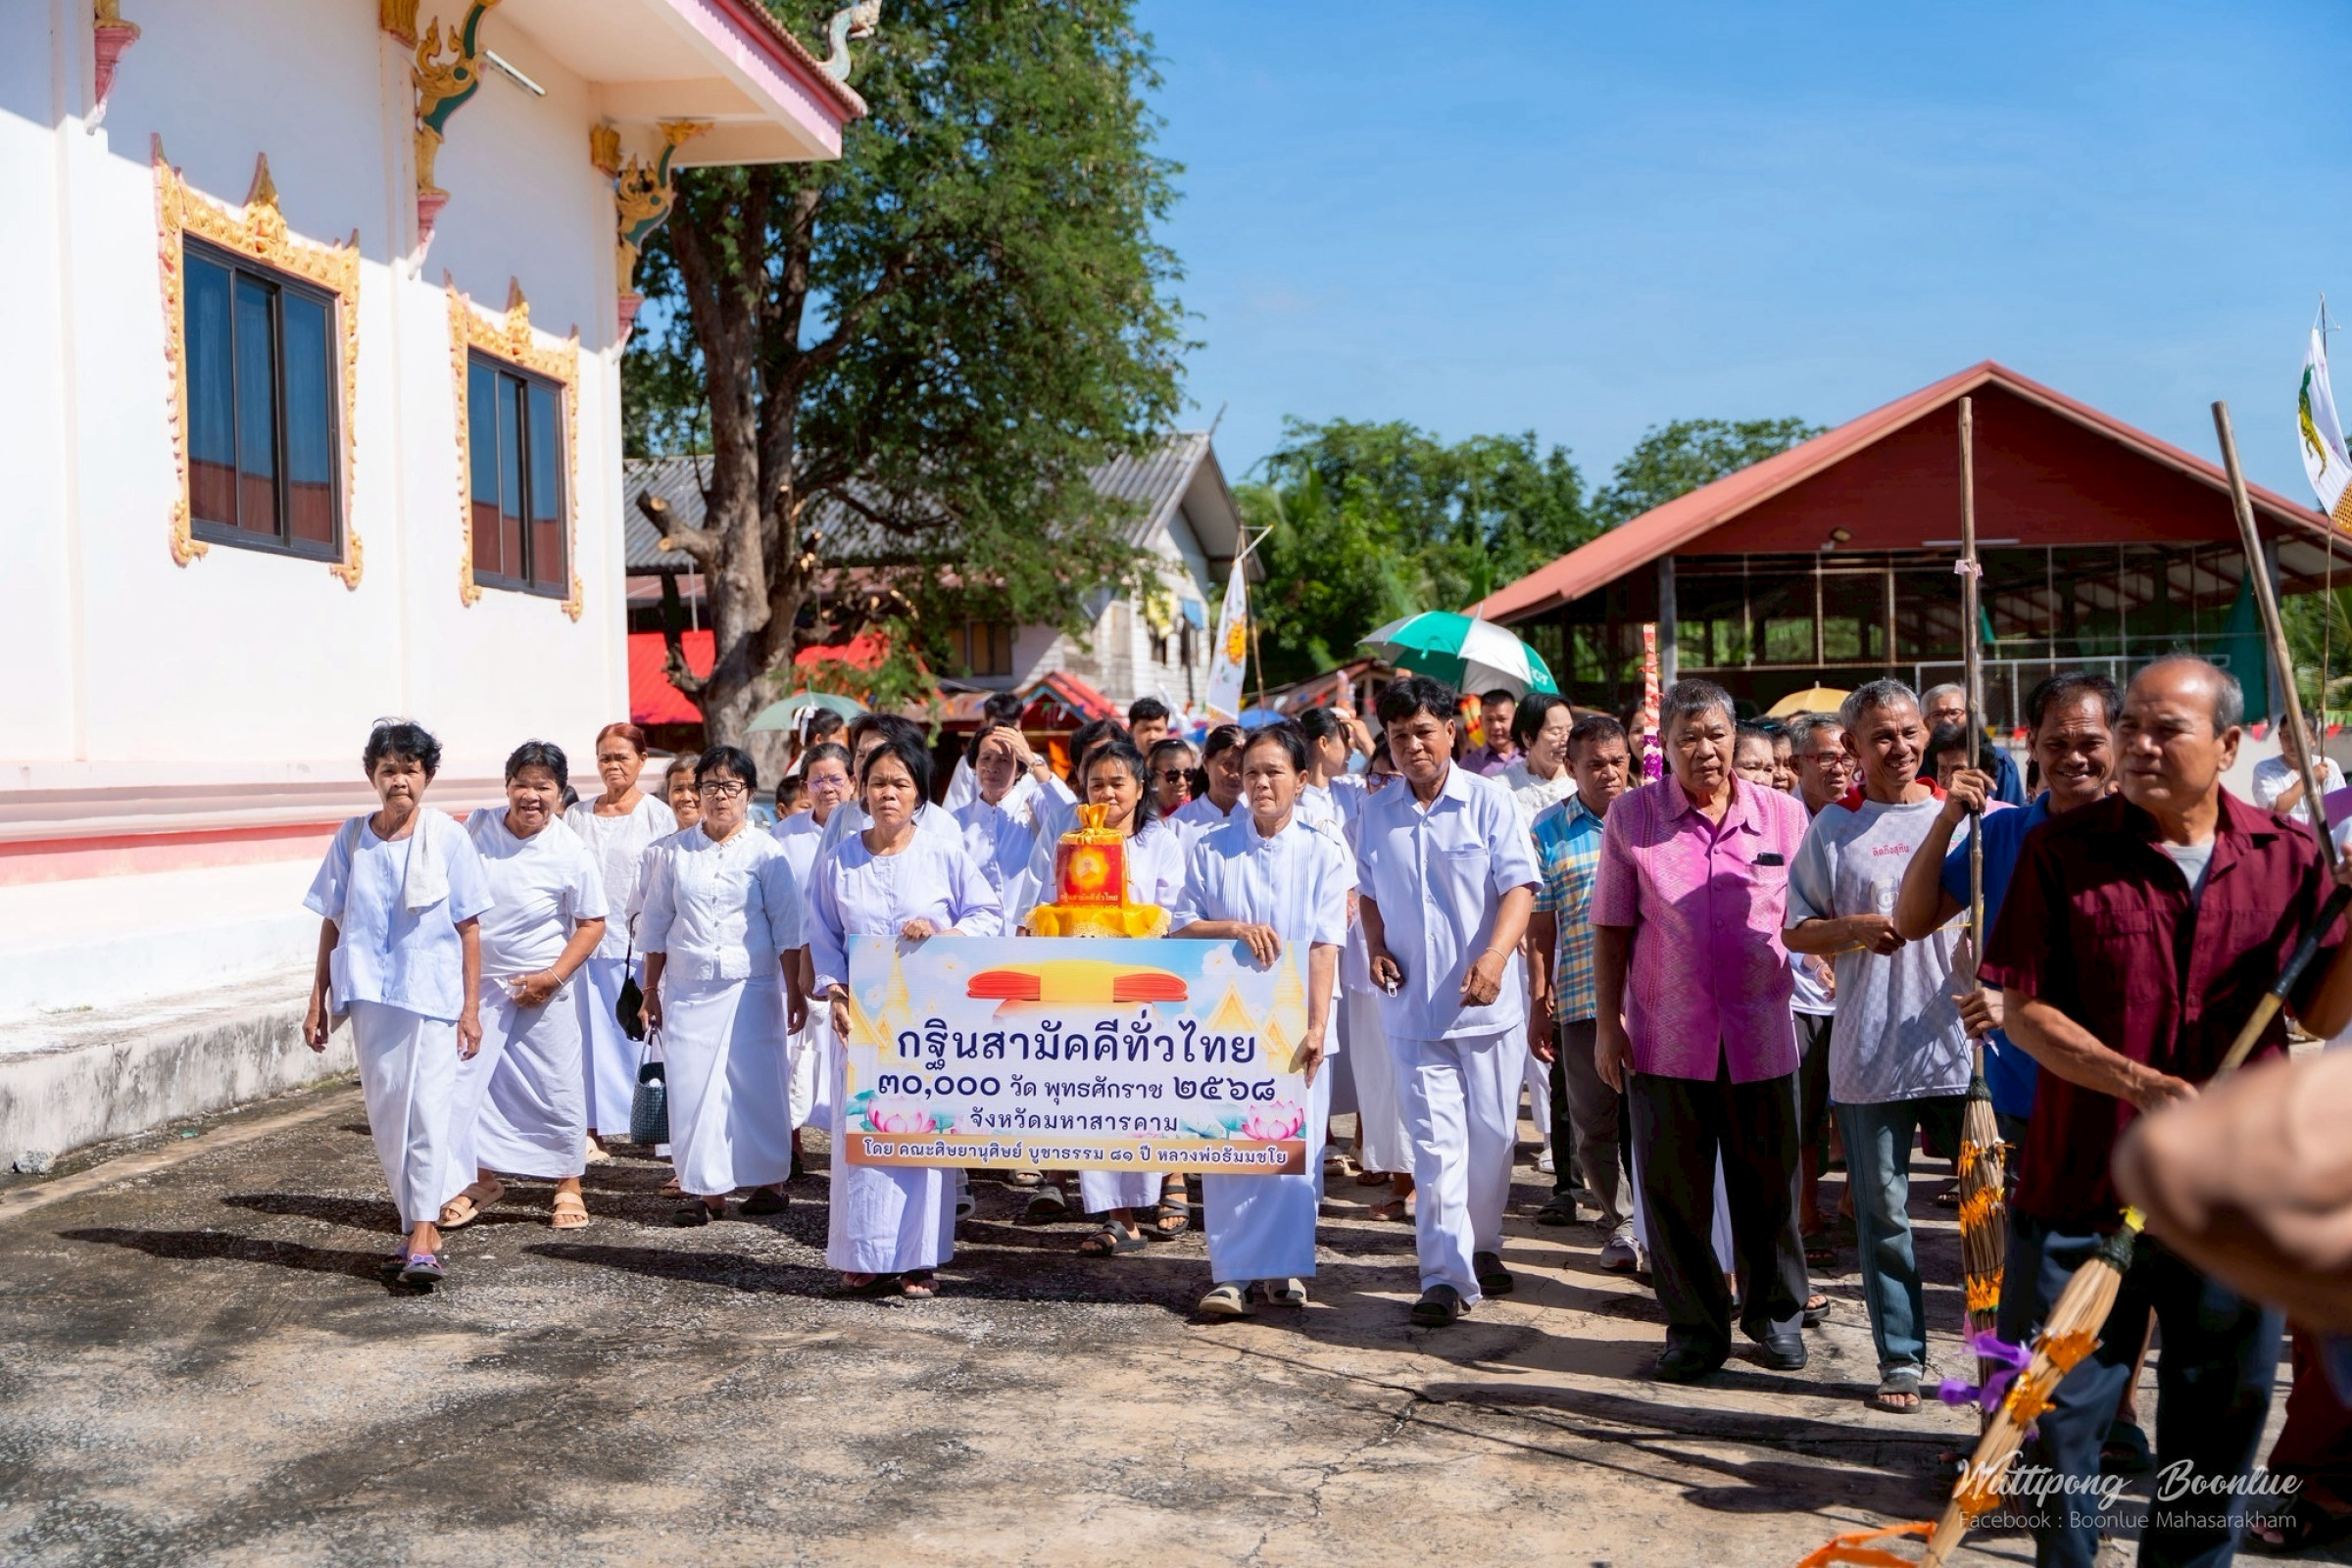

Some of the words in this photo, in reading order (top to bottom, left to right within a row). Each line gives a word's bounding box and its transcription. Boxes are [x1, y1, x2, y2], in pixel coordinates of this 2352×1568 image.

[898, 1009, 1255, 1070] กฐินสามัคคีทั่วไทย
[878, 1074, 1001, 1100] ๓๐,๐๐๐
[1010, 1074, 1037, 1097] วัด
[1044, 1076, 1163, 1105] พุทธศักราช
[1173, 1076, 1276, 1101] ๒๕๖๘
[970, 1106, 1177, 1132] จังหวัดมหาสารคาม
[863, 1139, 893, 1155] โดย
[900, 1141, 1022, 1162] คณะศิษยานุศิษย์
[1029, 1147, 1103, 1163] บูชาธรรม
[1109, 1152, 1134, 1162] ๘๑
[1140, 1145, 1152, 1161] ปี
[1157, 1147, 1287, 1163] หลวงพ่อธัมมชโย
